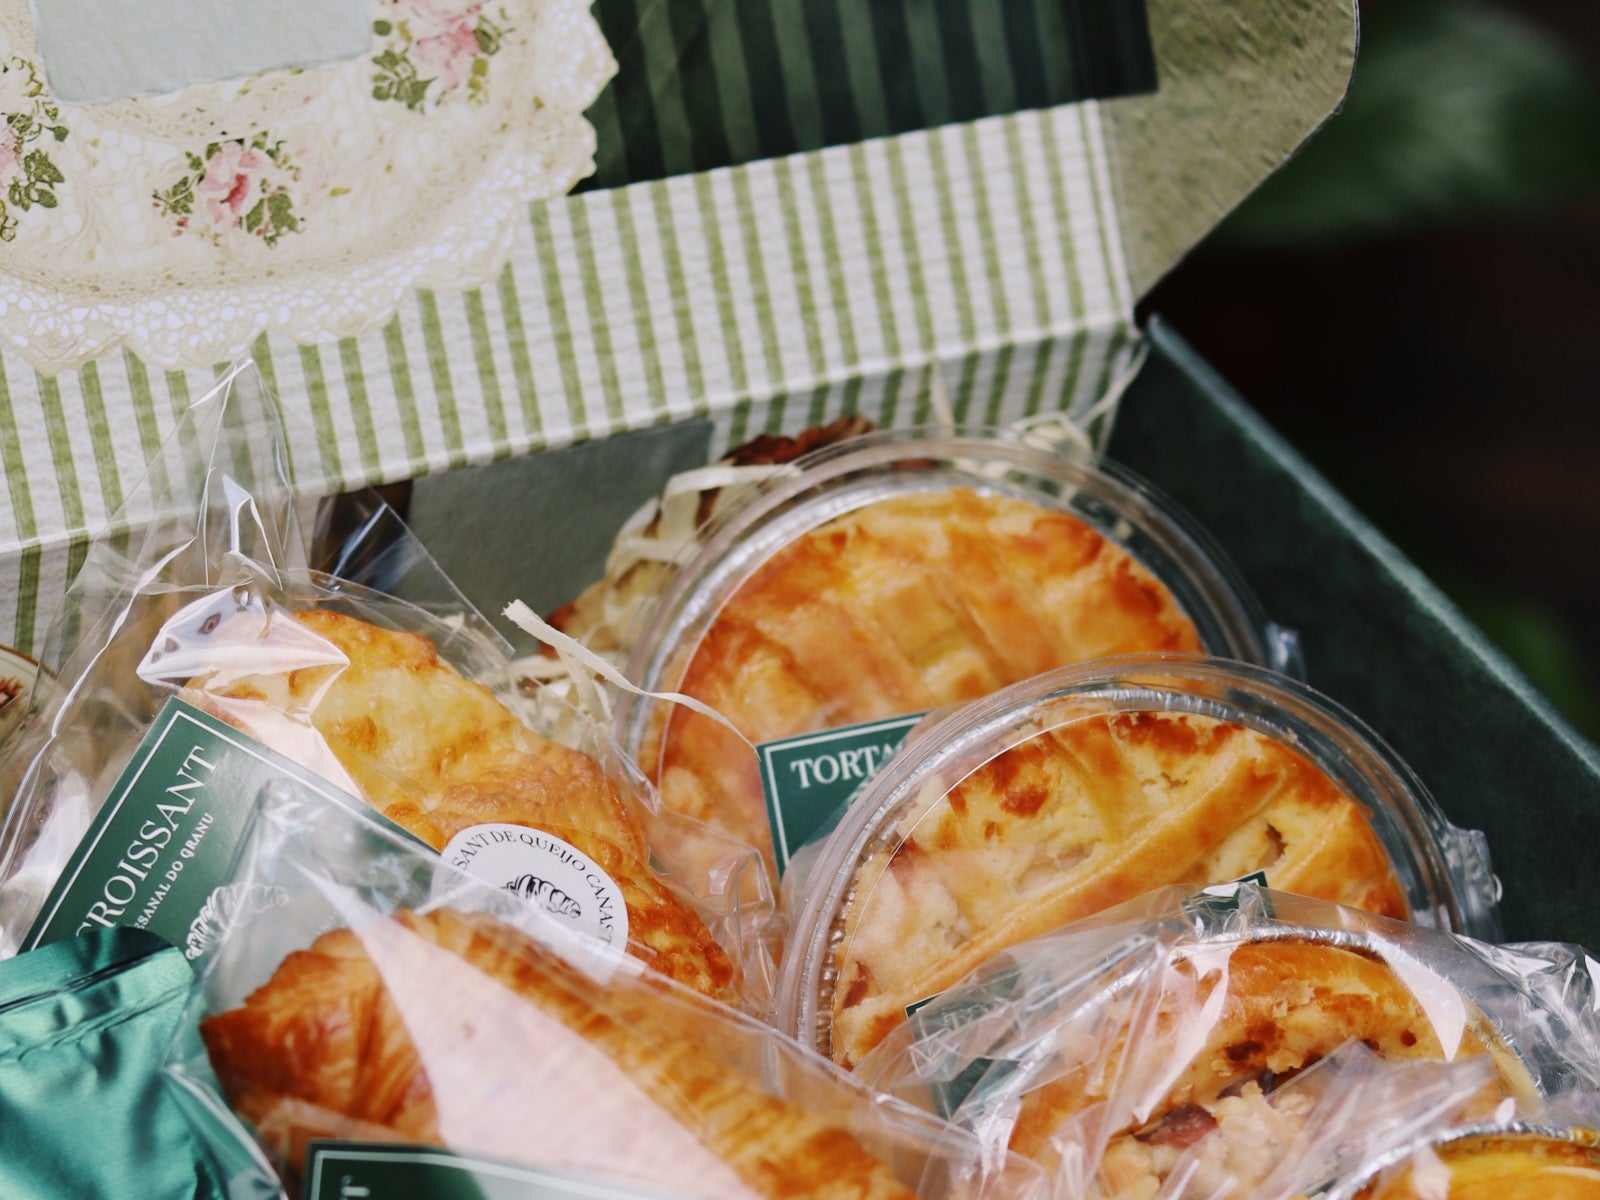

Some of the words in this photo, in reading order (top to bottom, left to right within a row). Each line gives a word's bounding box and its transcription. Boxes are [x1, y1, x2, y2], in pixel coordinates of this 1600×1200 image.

[164, 859, 185, 883] DO
[179, 811, 214, 860] GRANU
[493, 830, 517, 844] DE
[519, 832, 587, 873] QUEIJO
